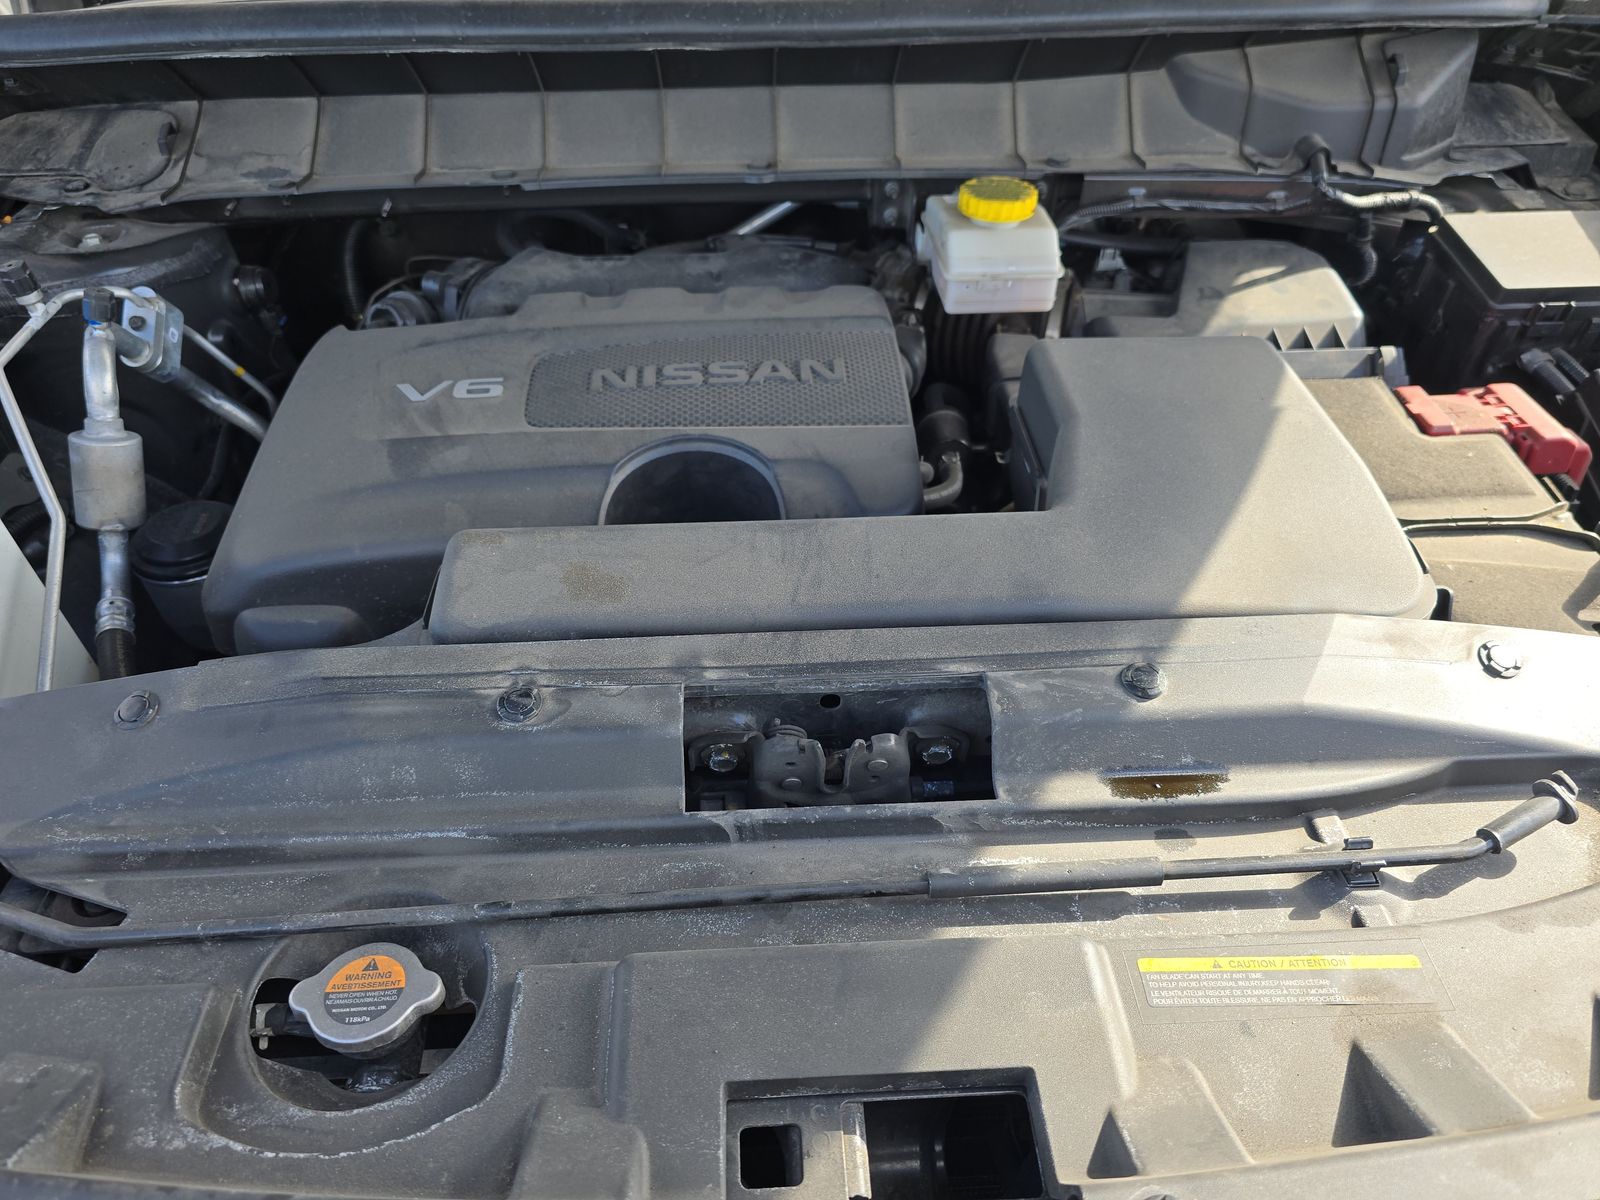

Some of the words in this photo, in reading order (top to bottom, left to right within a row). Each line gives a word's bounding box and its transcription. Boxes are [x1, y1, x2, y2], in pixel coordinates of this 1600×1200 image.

[590, 357, 847, 391] NISSAN
[396, 376, 505, 402] V6
[1228, 959, 1277, 969] CAUTION
[1288, 957, 1347, 968] ATTENTION
[345, 971, 392, 981] WARNING
[330, 980, 401, 990] AVERTISSEMENT
[349, 990, 365, 998] OPEN
[366, 989, 384, 997] WHEN
